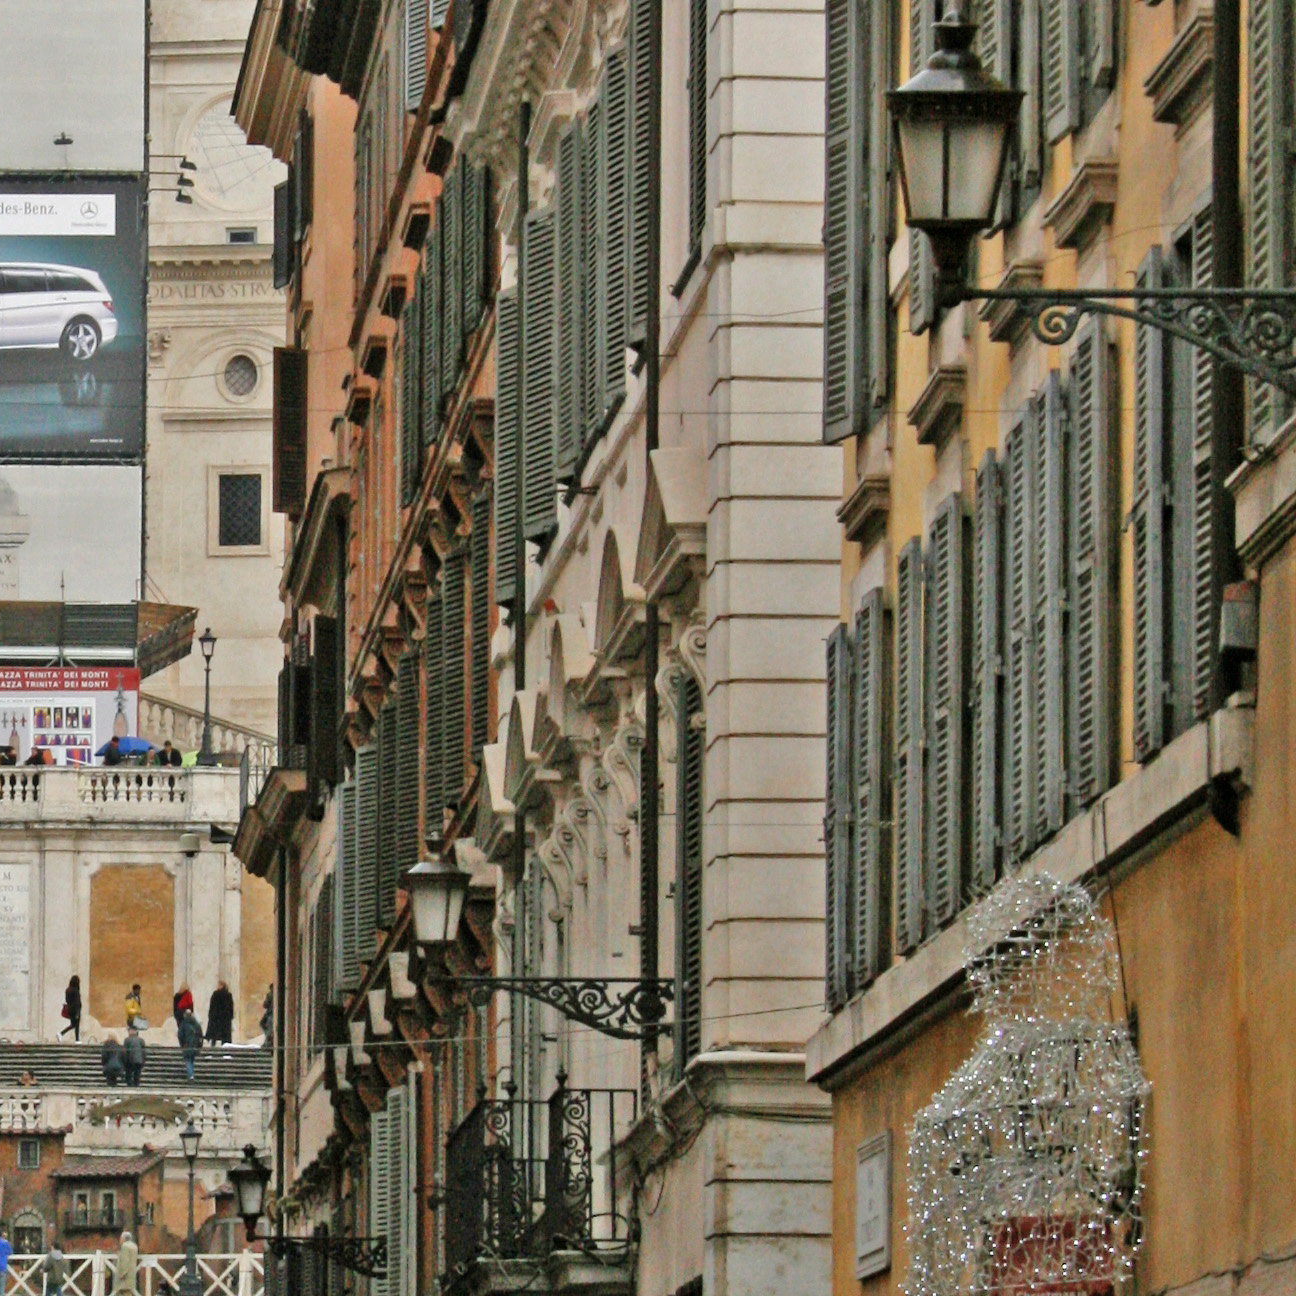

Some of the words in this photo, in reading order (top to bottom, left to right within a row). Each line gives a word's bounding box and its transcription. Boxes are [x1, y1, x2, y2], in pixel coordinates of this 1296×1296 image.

[24, 671, 61, 679] TRINITA'
[63, 671, 78, 679] DEI
[81, 671, 109, 679] MONTI
[25, 680, 62, 688] TRINITA'
[64, 680, 79, 688] DEI
[81, 680, 109, 688] MONTI
